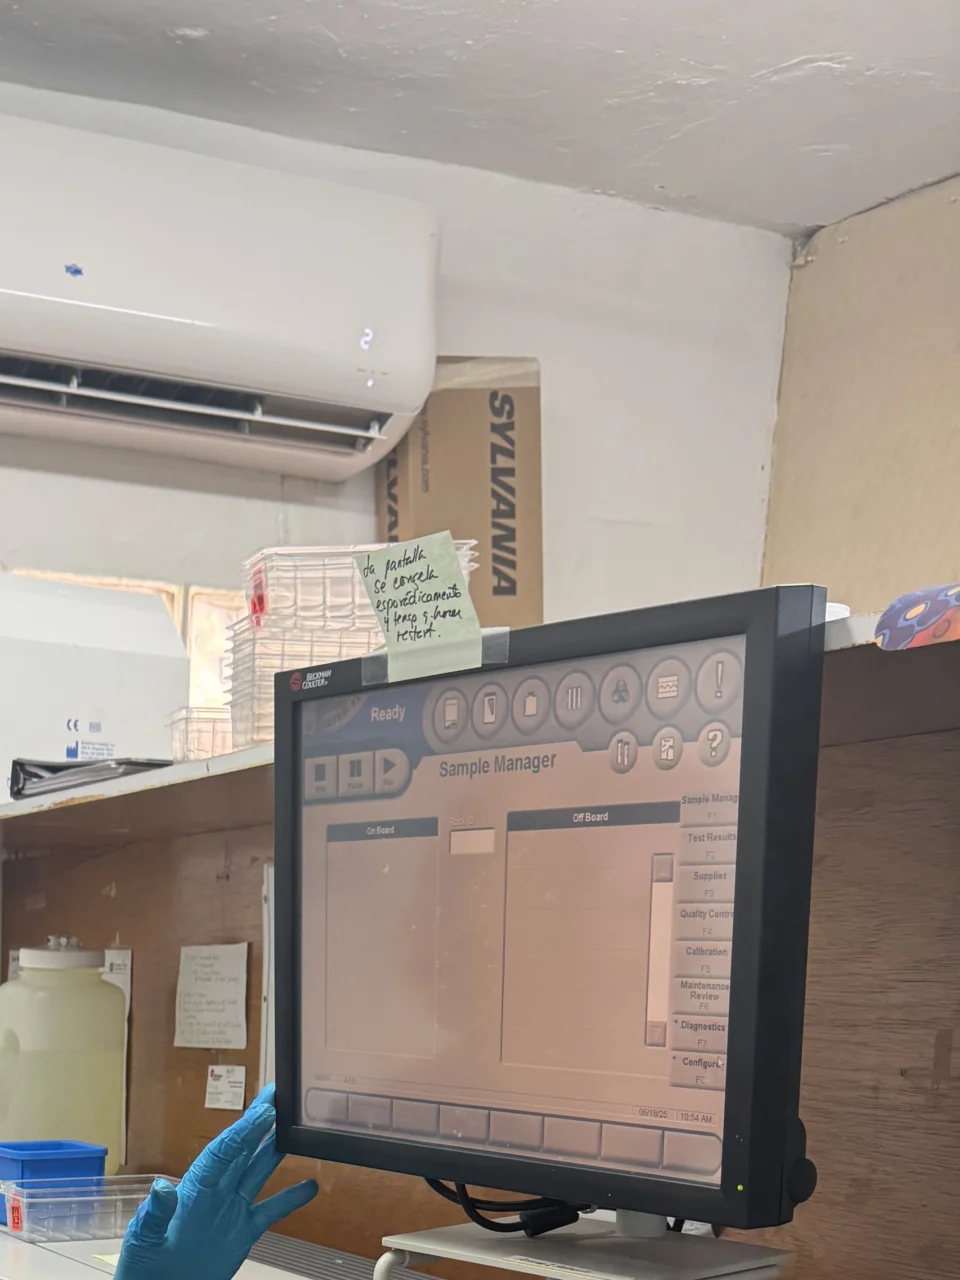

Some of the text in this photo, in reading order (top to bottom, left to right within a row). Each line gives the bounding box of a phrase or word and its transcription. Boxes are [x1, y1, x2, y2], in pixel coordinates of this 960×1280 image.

[489, 390, 517, 596] SYLVANIA
[306, 669, 332, 681] BECKMAN
[371, 704, 406, 722] Ready
[440, 753, 557, 779] Sample Manager
[681, 795, 710, 805] Sample
[573, 812, 609, 822] Off Board
[376, 825, 395, 835] Board
[688, 833, 736, 842] Test Results
[693, 871, 727, 881] Supplies
[680, 910, 706, 920] Quality
[686, 947, 728, 957] Calibration
[680, 980, 729, 990] Maintenance
[690, 991, 719, 1001] Review
[681, 1020, 726, 1031] Diagnostics
[681, 1112, 699, 1122] 10:54
[700, 1114, 712, 1123] AM
